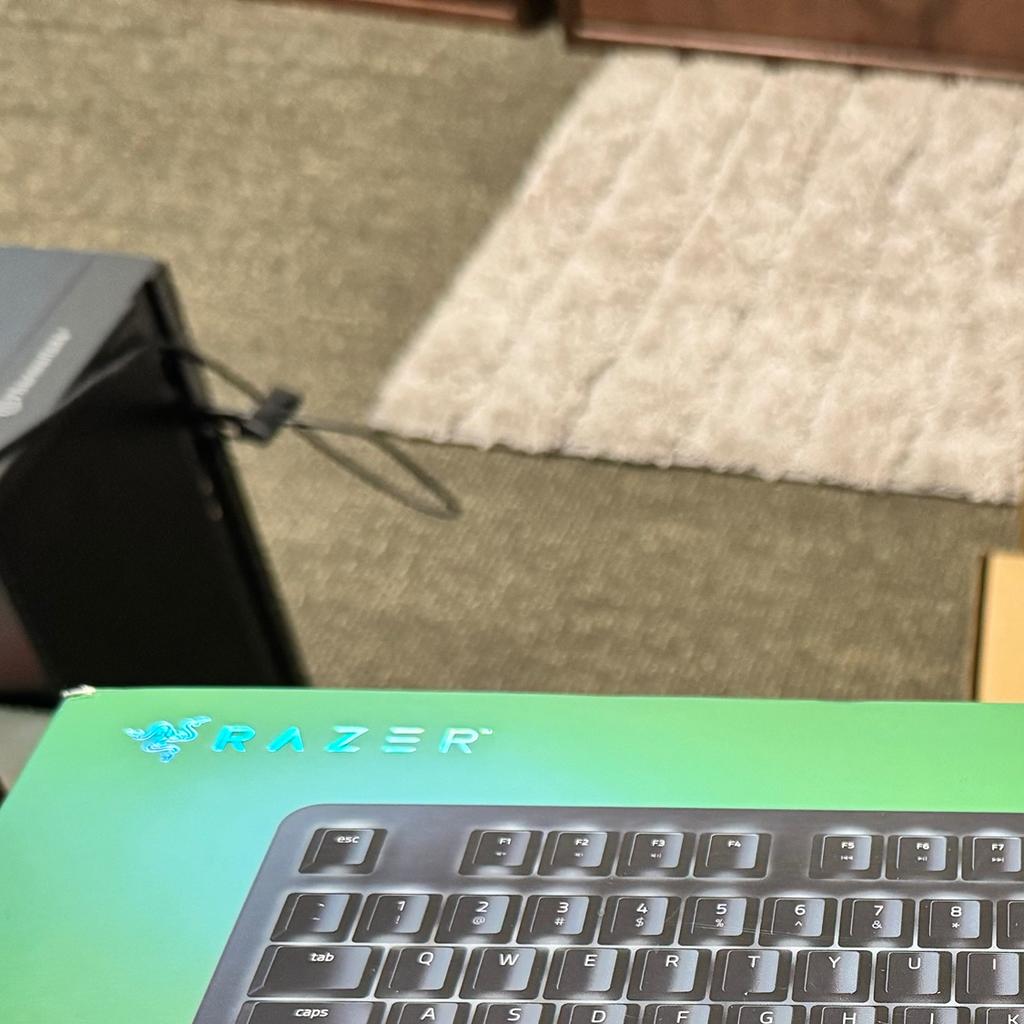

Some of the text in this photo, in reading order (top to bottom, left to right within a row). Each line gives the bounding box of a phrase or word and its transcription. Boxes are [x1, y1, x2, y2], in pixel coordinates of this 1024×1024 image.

[211, 725, 480, 753] RAZER
[337, 834, 360, 844] esc
[652, 839, 666, 847] F3
[728, 840, 742, 848] F4
[476, 902, 488, 912] 2
[557, 902, 569, 913] 3
[636, 903, 648, 914] 4
[716, 904, 727, 915] 5
[795, 904, 806, 915] 6
[874, 905, 884, 916] 7
[950, 906, 962, 917] 8
[472, 916, 485, 925] @
[554, 917, 566, 926] #
[635, 917, 644, 928] $
[714, 918, 724, 928] %
[871, 920, 882, 929] &
[311, 951, 335, 962] tab
[418, 951, 434, 966] Q
[500, 953, 519, 966] W
[583, 954, 598, 967] E
[665, 955, 679, 967] R
[748, 955, 761, 968] T
[828, 956, 841, 969] Y
[908, 957, 921, 970] U
[295, 1007, 328, 1018] caps
[420, 1007, 437, 1021] A
[507, 1008, 521, 1022] S
[591, 1010, 606, 1024] D
[676, 1010, 690, 1024] F
[760, 1011, 774, 1024] G
[842, 1012, 856, 1024] H
